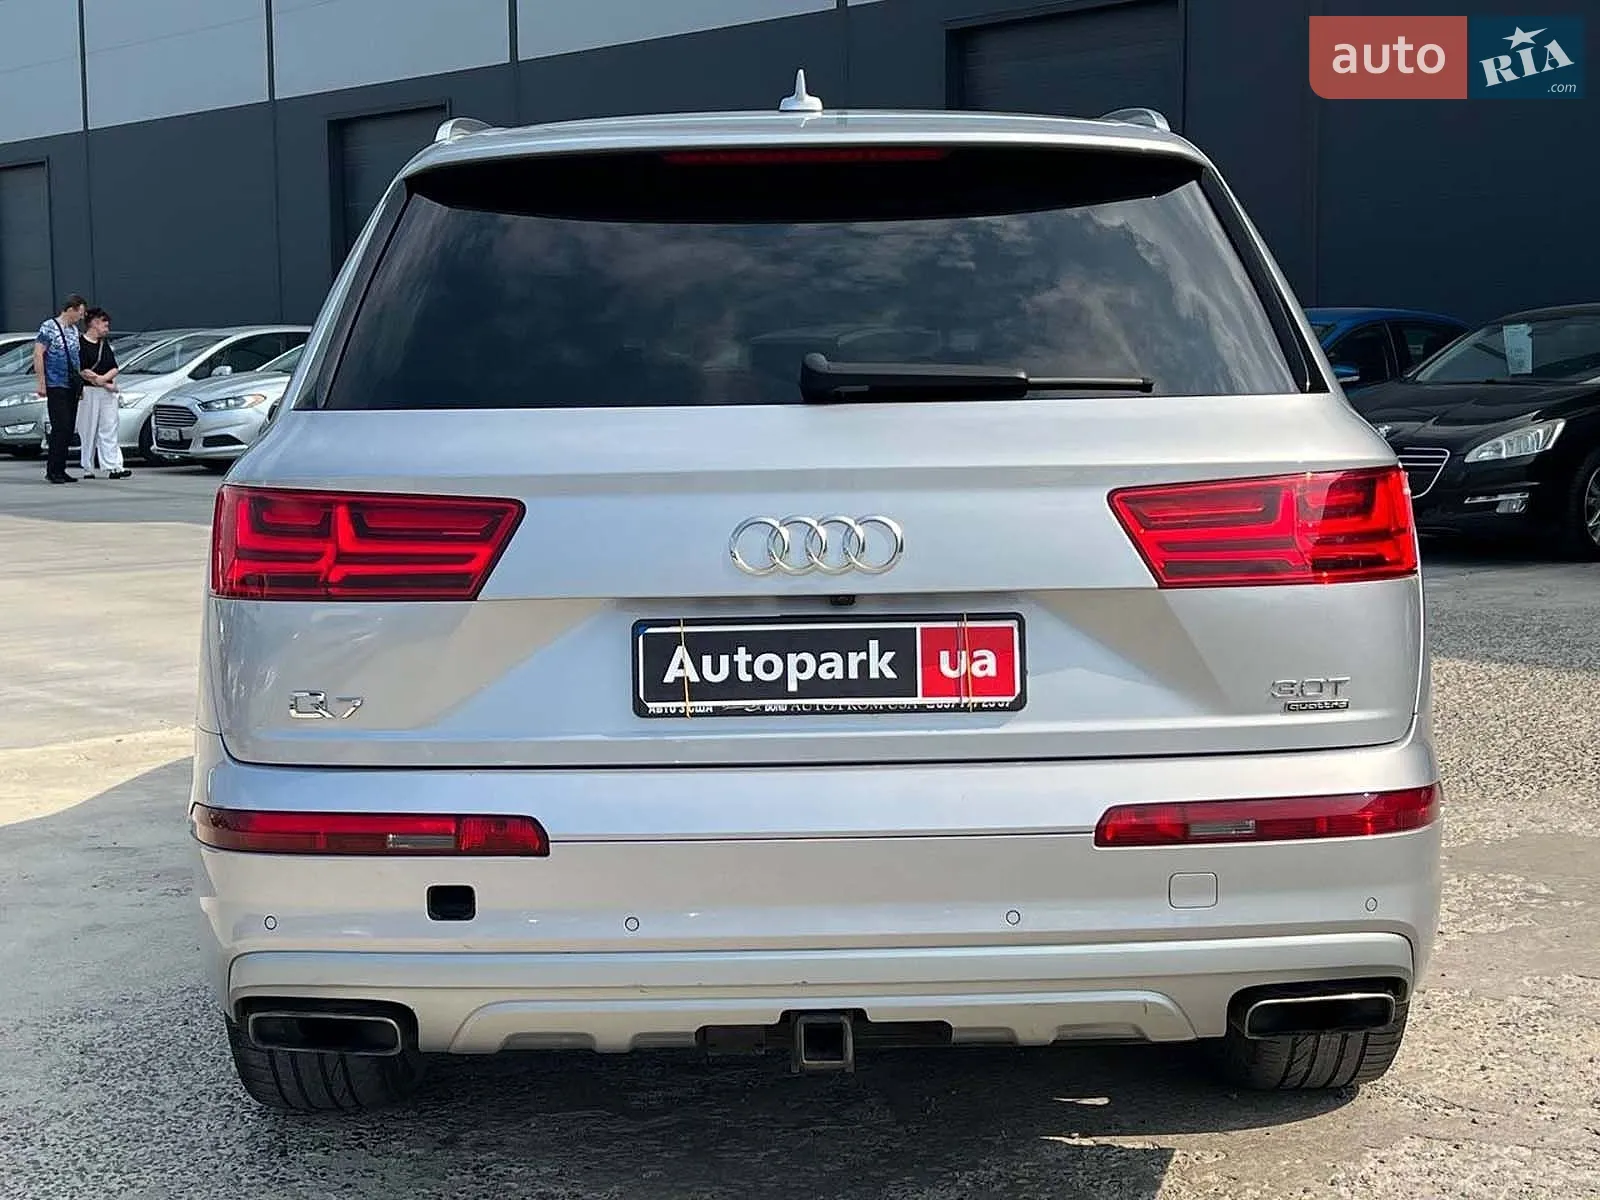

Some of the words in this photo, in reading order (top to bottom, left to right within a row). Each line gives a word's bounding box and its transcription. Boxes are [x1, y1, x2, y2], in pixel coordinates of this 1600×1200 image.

[662, 639, 901, 692] Autopark
[938, 647, 997, 679] ua
[289, 690, 364, 720] Q7
[1287, 701, 1349, 712] quattro
